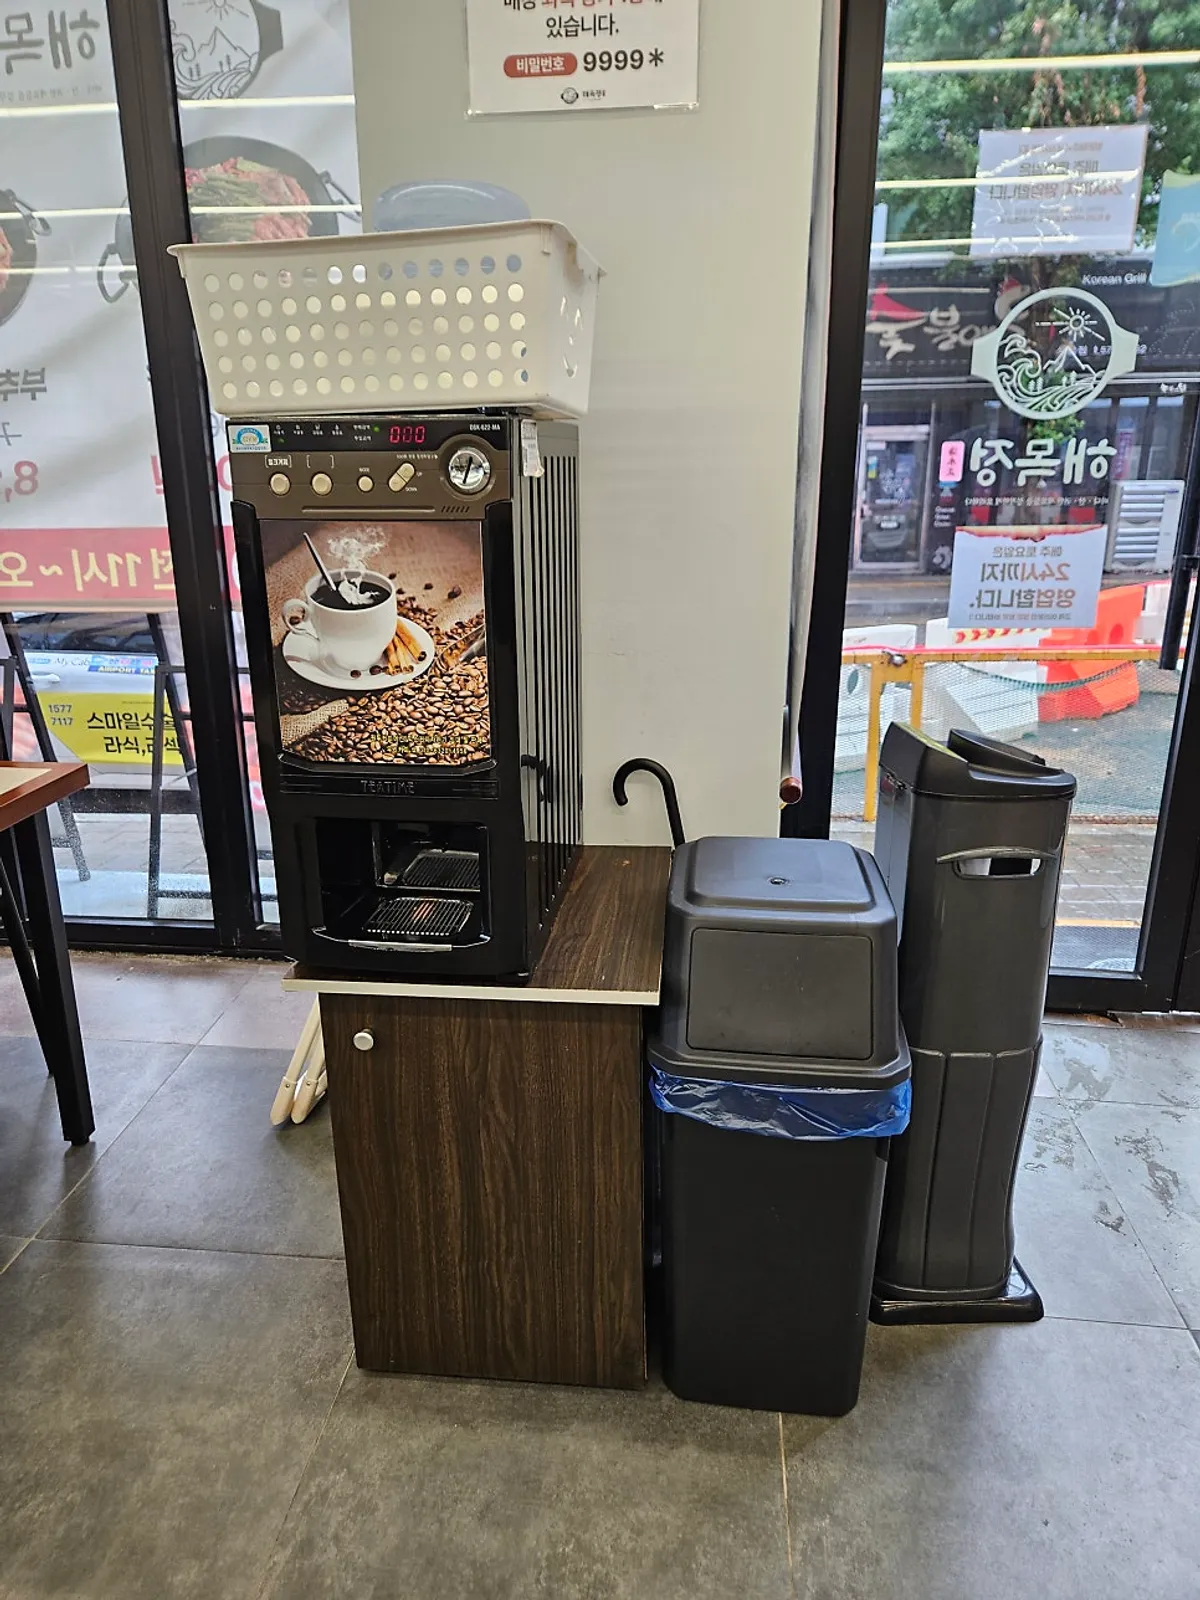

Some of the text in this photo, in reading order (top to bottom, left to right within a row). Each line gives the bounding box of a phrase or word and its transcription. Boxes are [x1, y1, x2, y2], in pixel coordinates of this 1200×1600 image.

[546, 13, 620, 38] 있습니다.
[516, 56, 566, 74] 비밀번호
[1082, 273, 1147, 285] Korean Grill
[389, 425, 426, 443] 000
[48, 704, 73, 713] 1577
[51, 717, 74, 726] 7117
[360, 780, 415, 794] TEATIME
